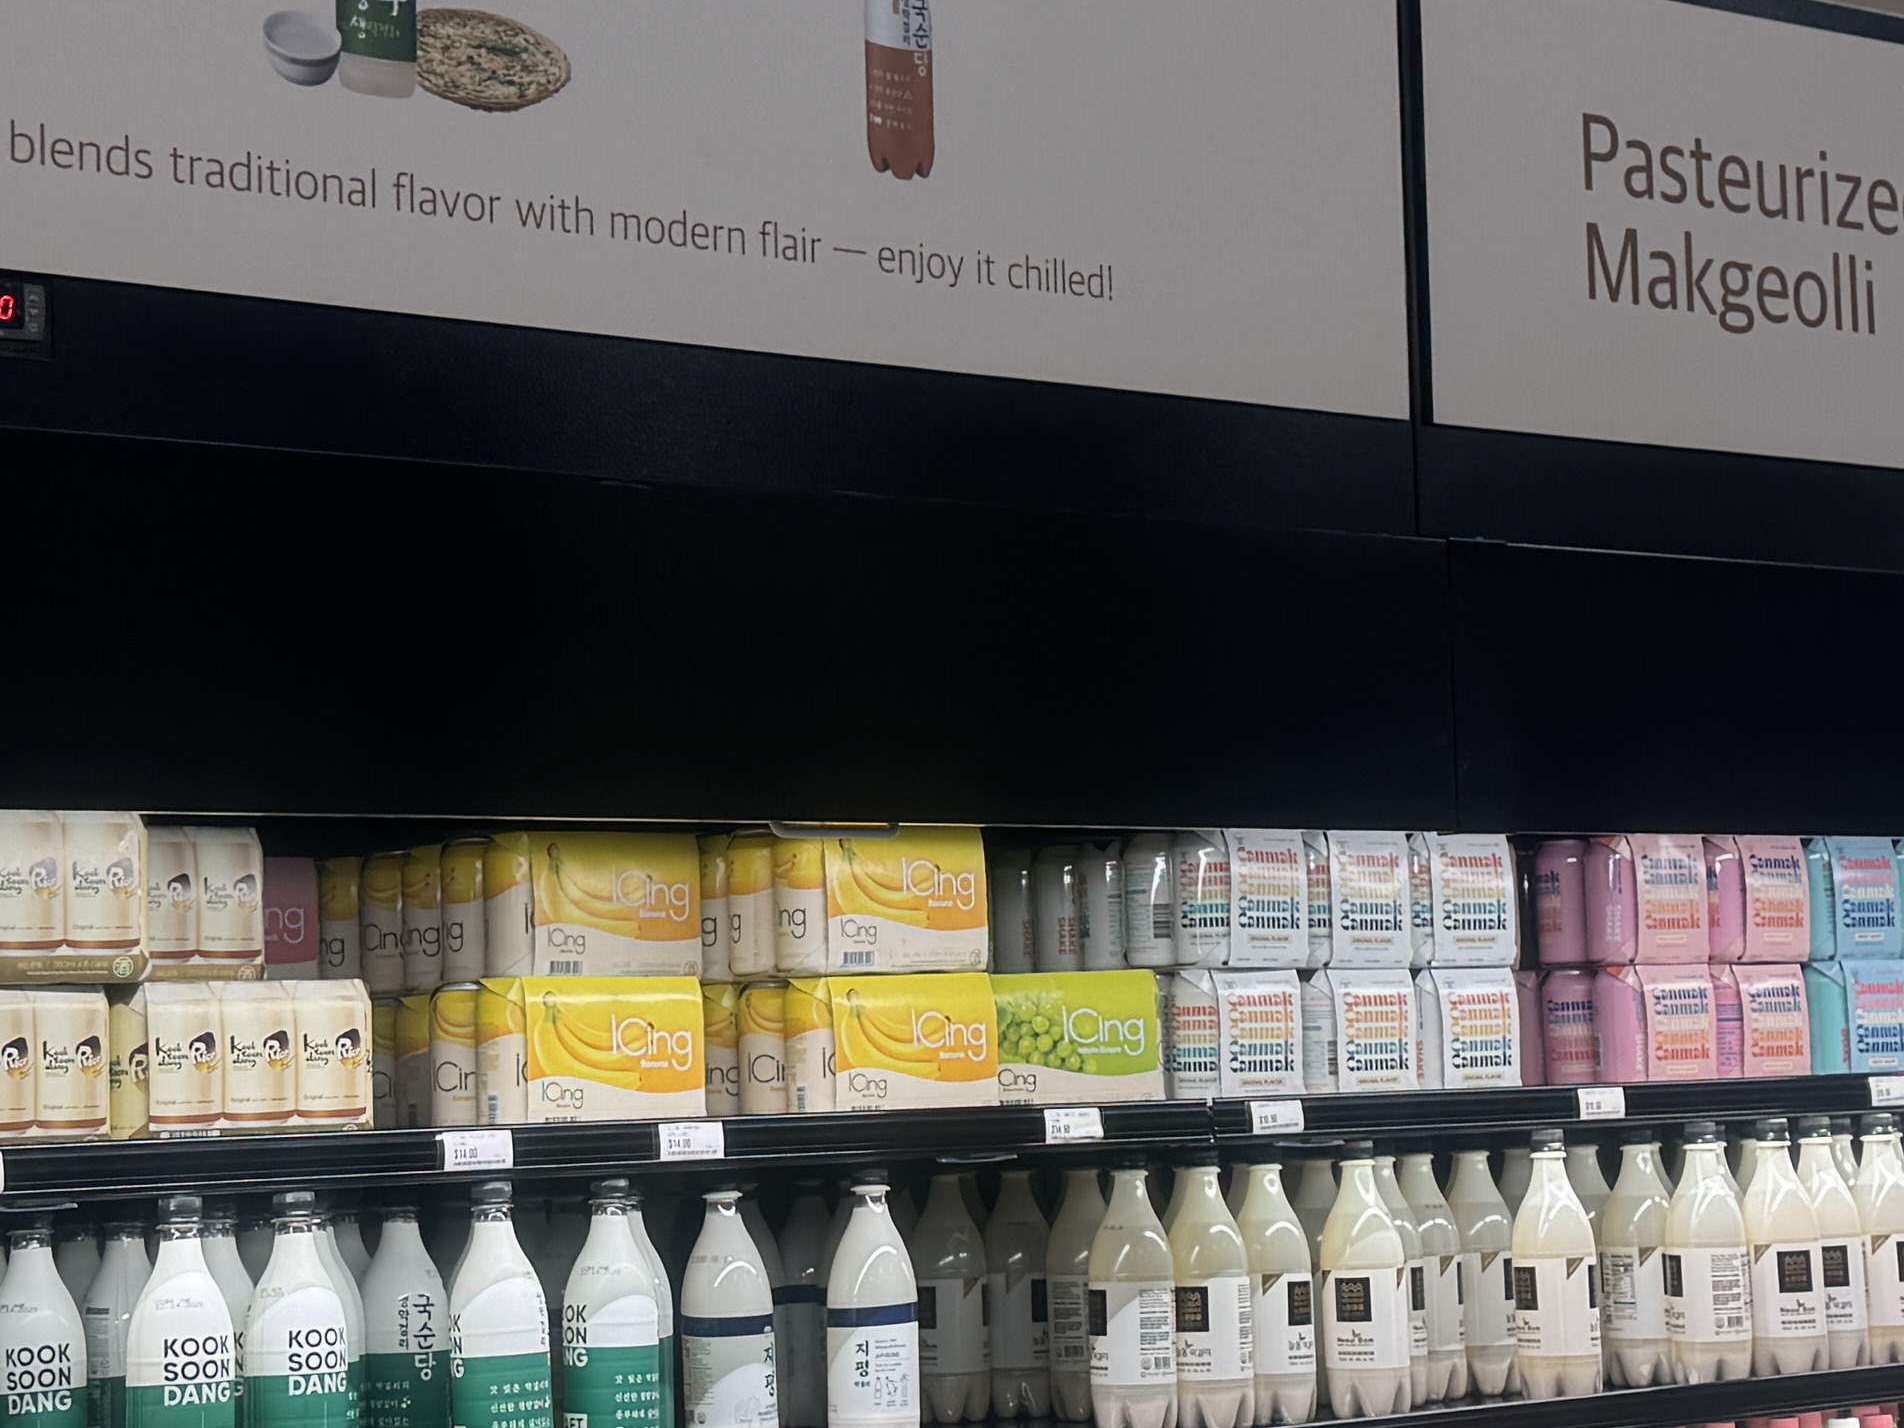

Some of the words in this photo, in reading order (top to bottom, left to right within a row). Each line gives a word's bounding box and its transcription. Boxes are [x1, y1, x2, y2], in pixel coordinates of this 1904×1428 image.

[10, 121, 154, 180] blends
[169, 146, 377, 210] traditional
[392, 172, 501, 226] flavor
[515, 193, 596, 237] with
[610, 208, 747, 259] modern
[758, 220, 822, 266] flair
[877, 241, 964, 289] enjoy
[975, 250, 996, 288] it
[1006, 256, 1115, 301] chilled!
[1586, 222, 1875, 335] Makgeolli
[163, 1335, 230, 1359] KOOK
[288, 1327, 347, 1350] KOOK
[412, 1294, 437, 1381] 국순당
[6, 1344, 71, 1368] KOOK
[288, 1350, 348, 1372] SOON
[854, 1340, 870, 1377] 지평
[6, 1367, 72, 1391] SOON
[164, 1358, 230, 1383] SOON
[164, 1381, 231, 1407] DANG
[288, 1372, 348, 1398] DANG
[7, 1390, 72, 1415] DANG
